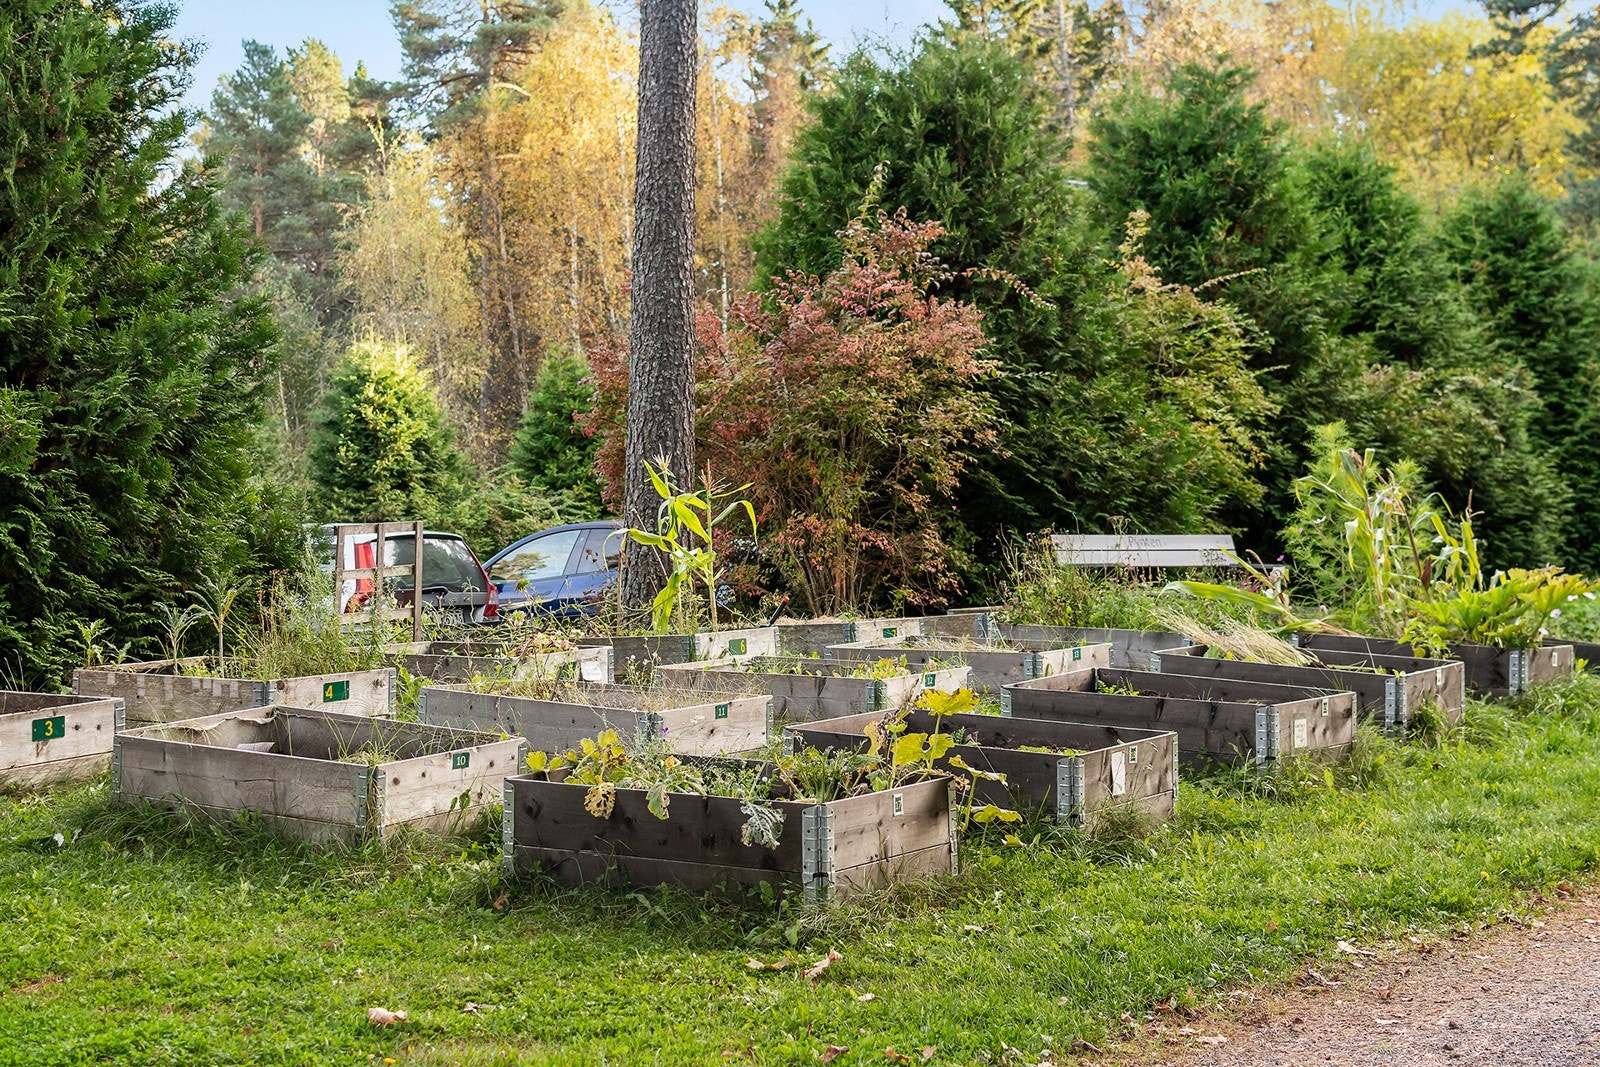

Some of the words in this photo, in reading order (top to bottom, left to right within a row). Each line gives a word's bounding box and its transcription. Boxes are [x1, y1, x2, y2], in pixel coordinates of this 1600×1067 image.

[740, 639, 746, 653] 6
[927, 676, 934, 685] 12
[325, 685, 333, 699] 4
[718, 707, 725, 716] 11
[45, 720, 54, 737] 3
[457, 755, 466, 766] 10
